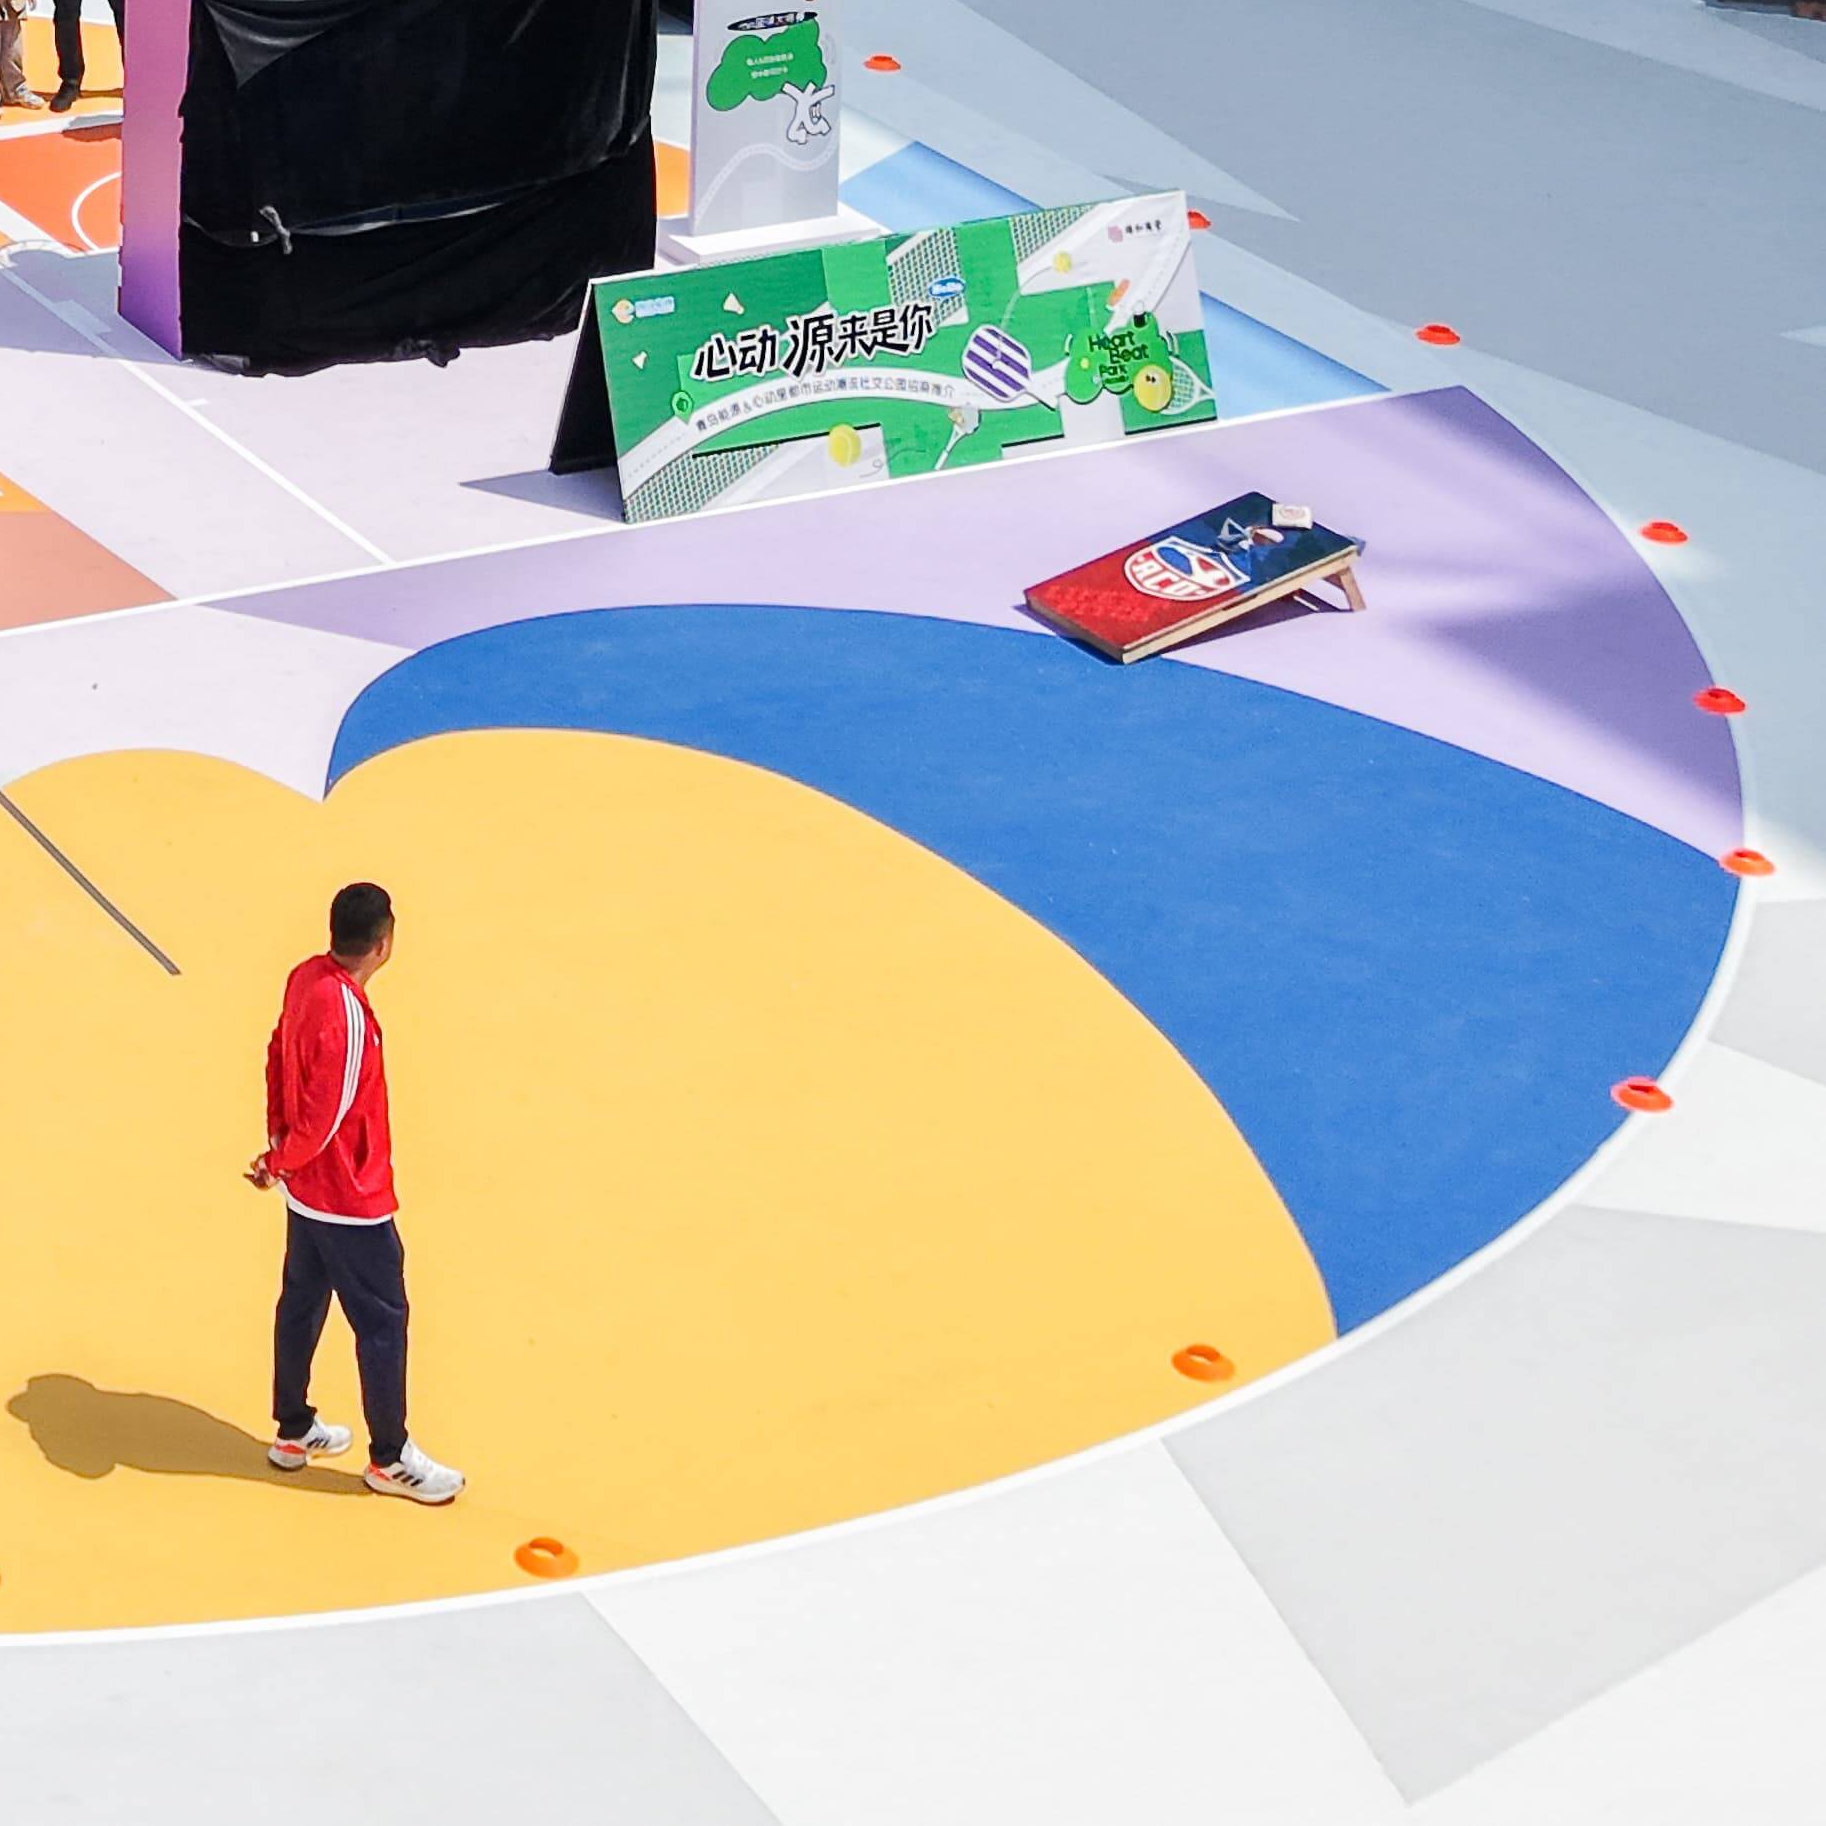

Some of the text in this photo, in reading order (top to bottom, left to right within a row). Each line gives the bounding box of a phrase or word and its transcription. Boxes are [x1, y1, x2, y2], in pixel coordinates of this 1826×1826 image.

[694, 304, 933, 377] 心动源来是你
[1089, 331, 1135, 352] Heart
[1109, 346, 1150, 364] Beat
